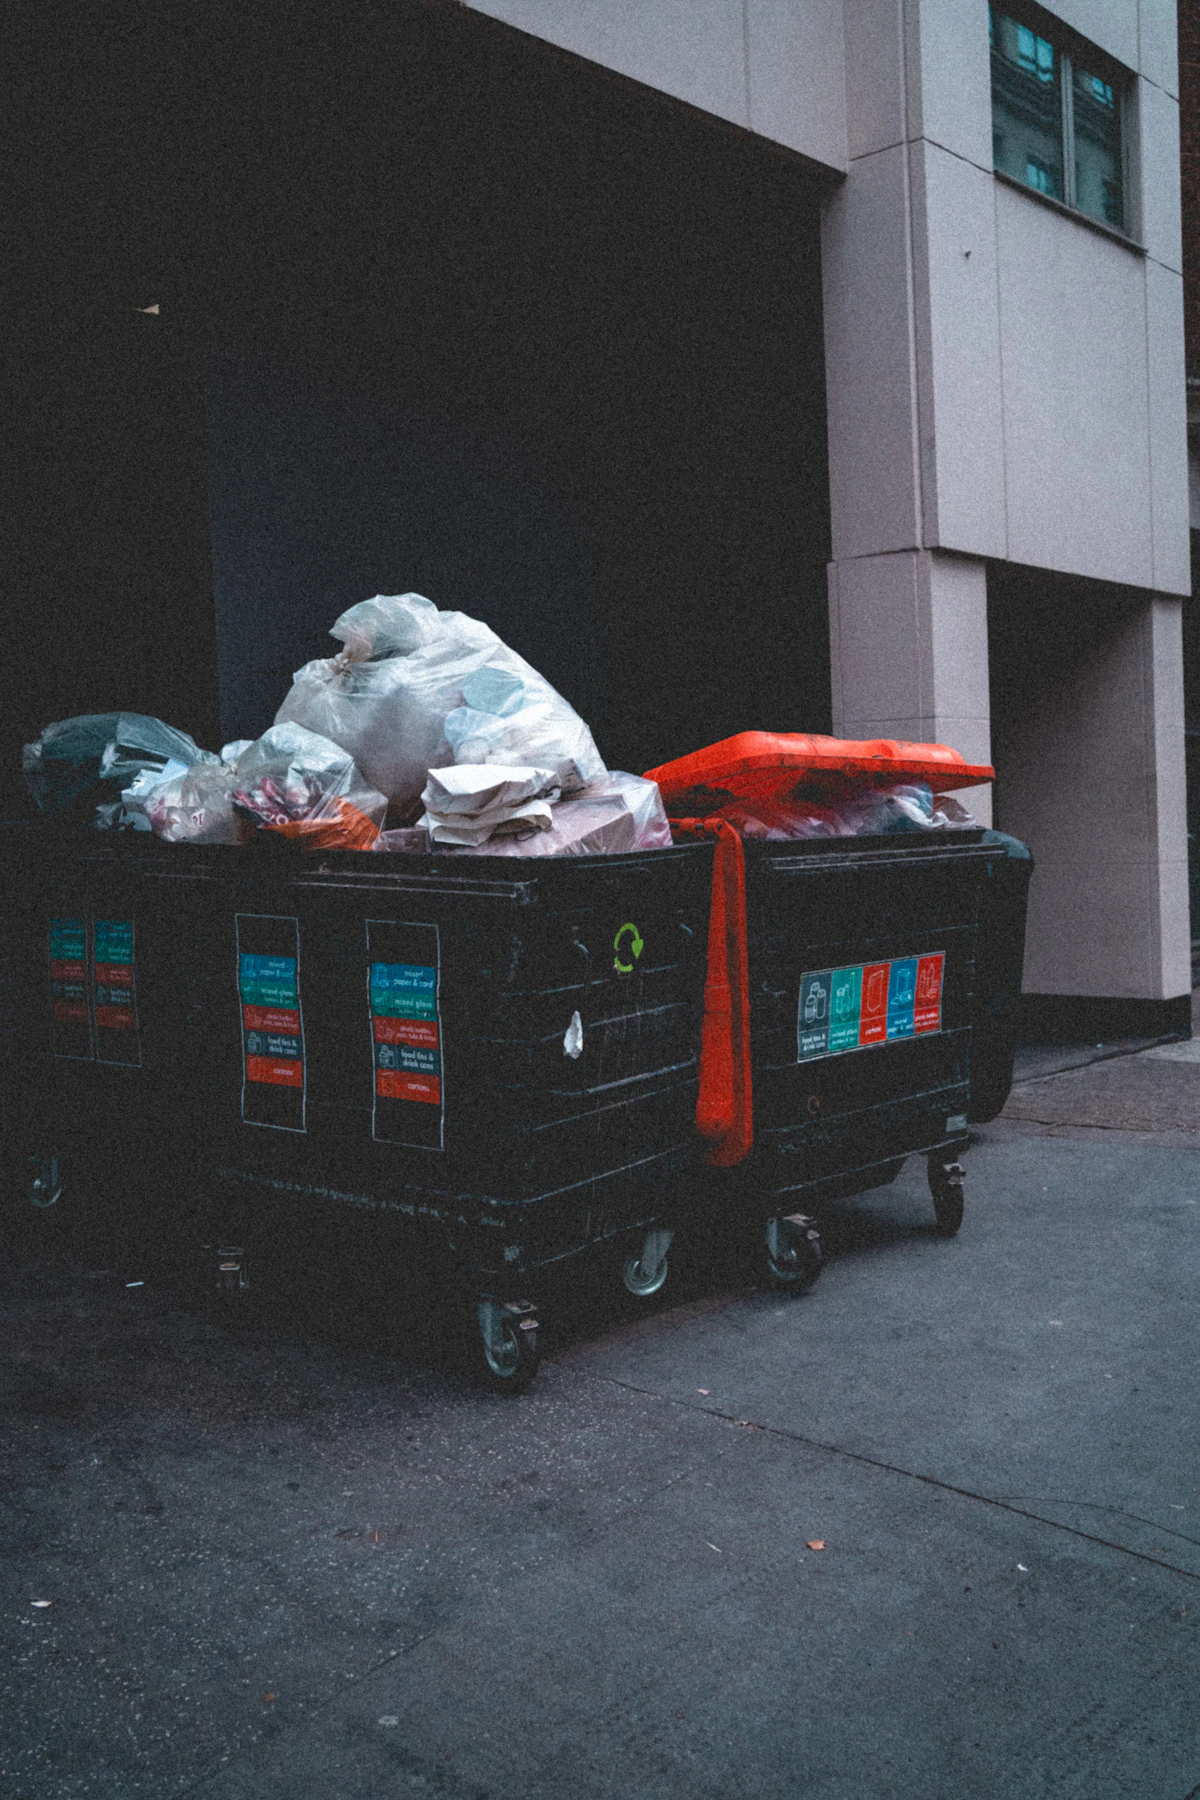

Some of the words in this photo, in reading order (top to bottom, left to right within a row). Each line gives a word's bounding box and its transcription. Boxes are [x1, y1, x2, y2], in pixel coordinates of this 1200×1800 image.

[393, 979, 412, 987] paper
[412, 978, 418, 987] &
[419, 980, 434, 989] card
[394, 998, 414, 1007] mixed
[415, 999, 432, 1009] glass
[401, 1049, 415, 1059] food
[416, 1051, 427, 1061] tins
[428, 1052, 434, 1061] &
[402, 1058, 418, 1068] drink
[419, 1062, 434, 1070] cans
